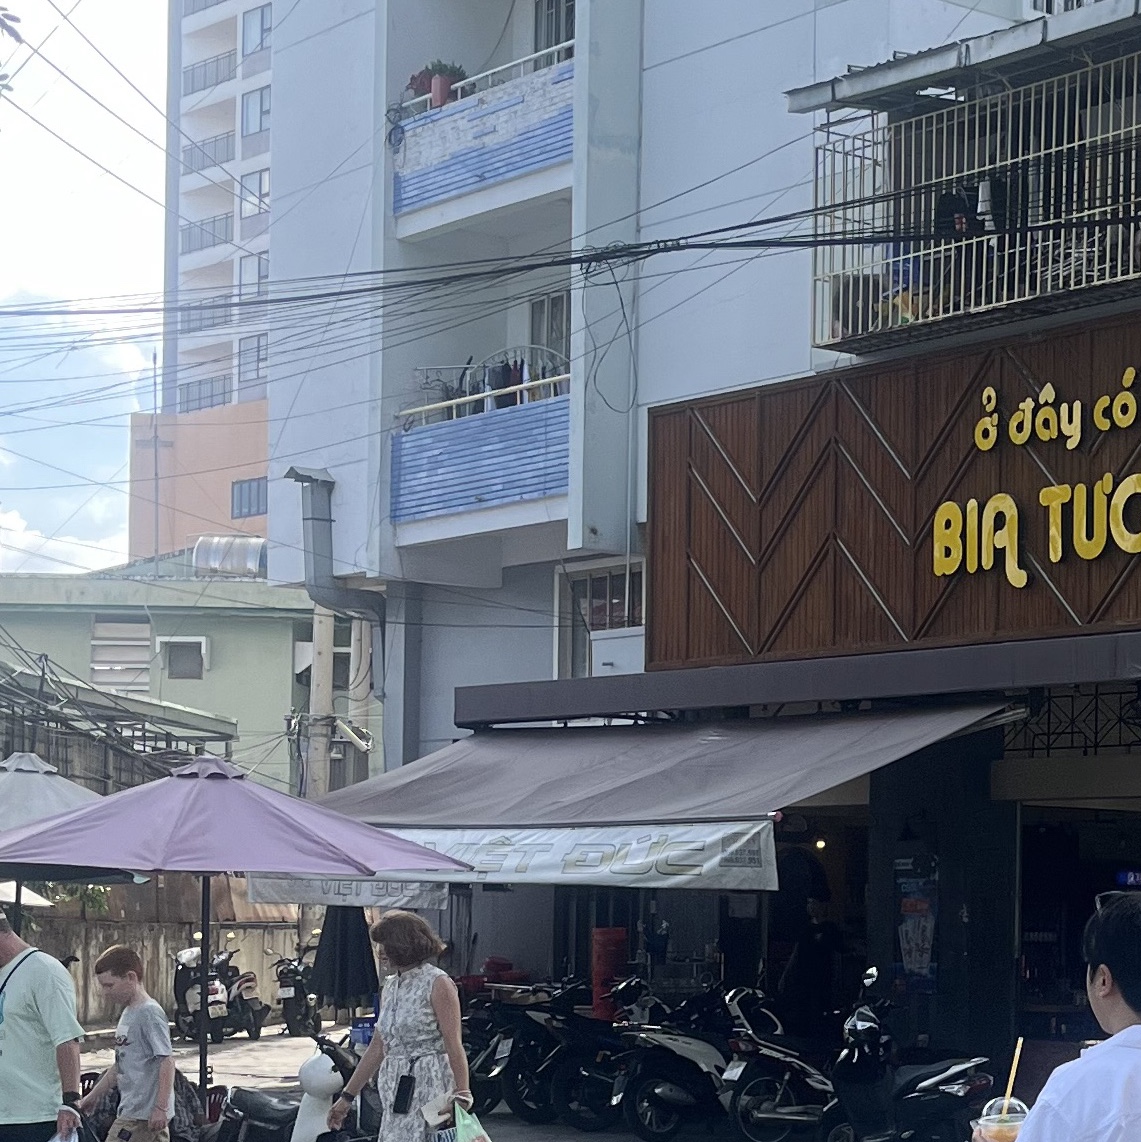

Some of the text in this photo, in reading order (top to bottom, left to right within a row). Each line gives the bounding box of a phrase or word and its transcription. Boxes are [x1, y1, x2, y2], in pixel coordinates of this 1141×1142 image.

[974, 366, 1138, 451] ở đây có
[933, 492, 1028, 588] BIA
[561, 834, 706, 876] ĐỨC
